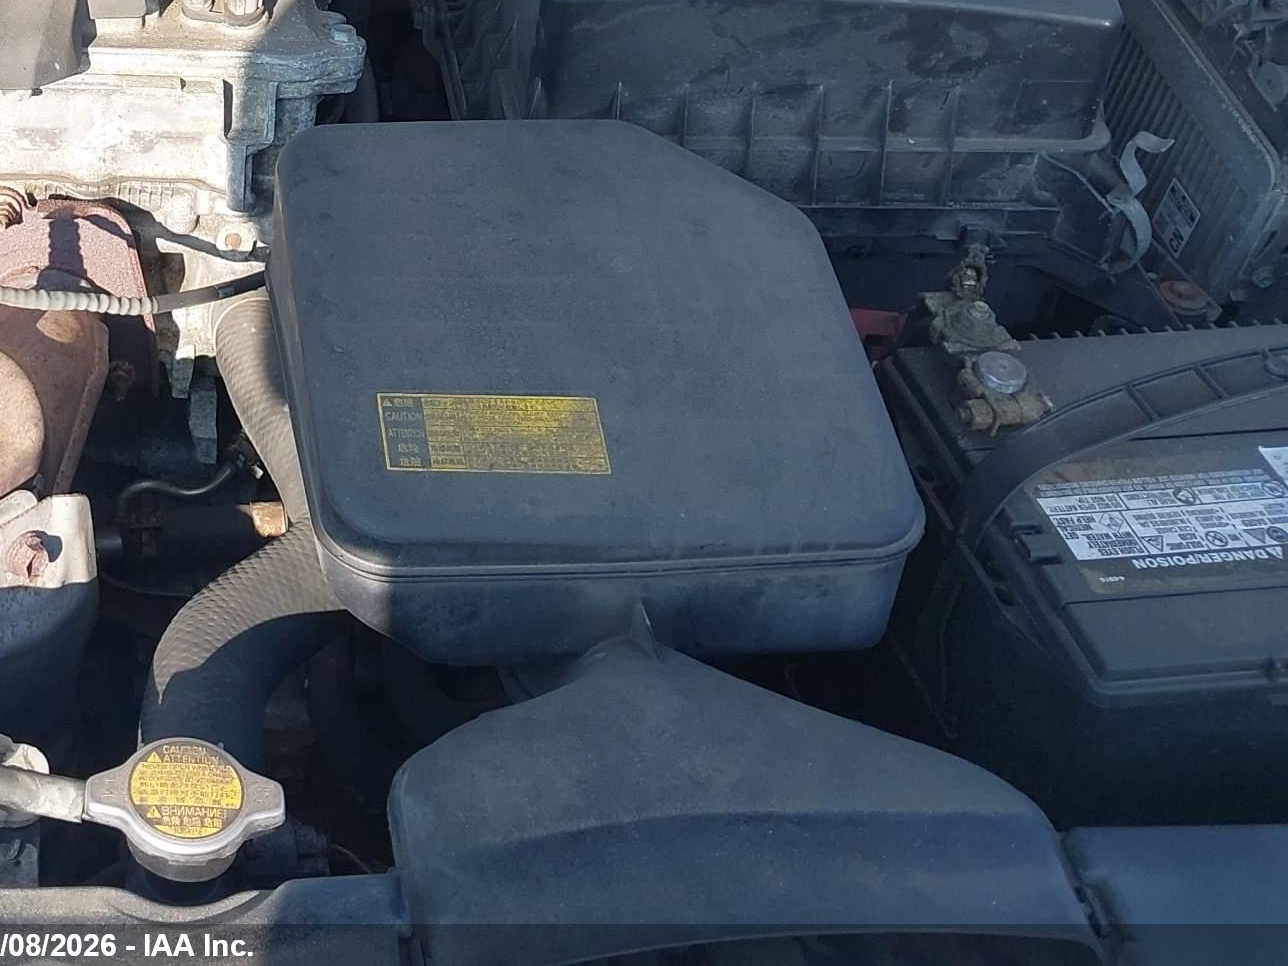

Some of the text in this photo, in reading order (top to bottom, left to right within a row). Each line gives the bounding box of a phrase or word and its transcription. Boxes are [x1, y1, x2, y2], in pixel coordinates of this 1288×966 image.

[1131, 548, 1269, 570] DANGER/POISON
[162, 745, 206, 755] CAUTION
[163, 754, 220, 765] ATTENTION
